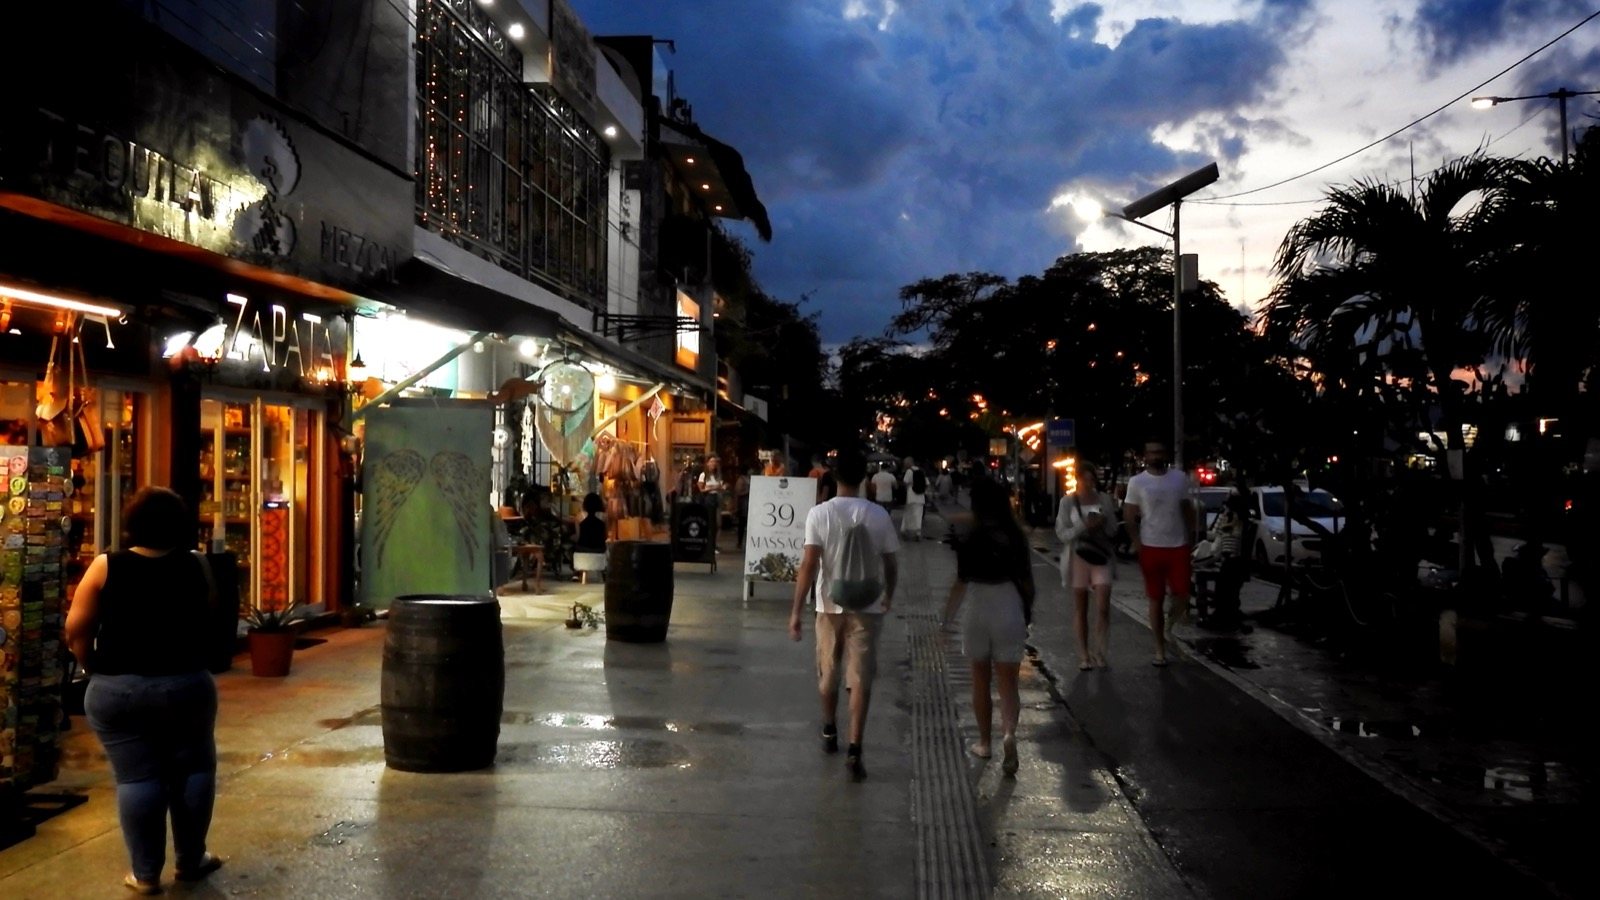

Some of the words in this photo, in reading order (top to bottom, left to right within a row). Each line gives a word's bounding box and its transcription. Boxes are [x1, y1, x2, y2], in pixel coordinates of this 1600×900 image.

[38, 107, 214, 218] TEQUILA
[320, 219, 400, 285] MEZCAL
[226, 293, 337, 381] ZAPATA
[750, 535, 806, 550] MASSAG
[761, 502, 795, 528] 39
